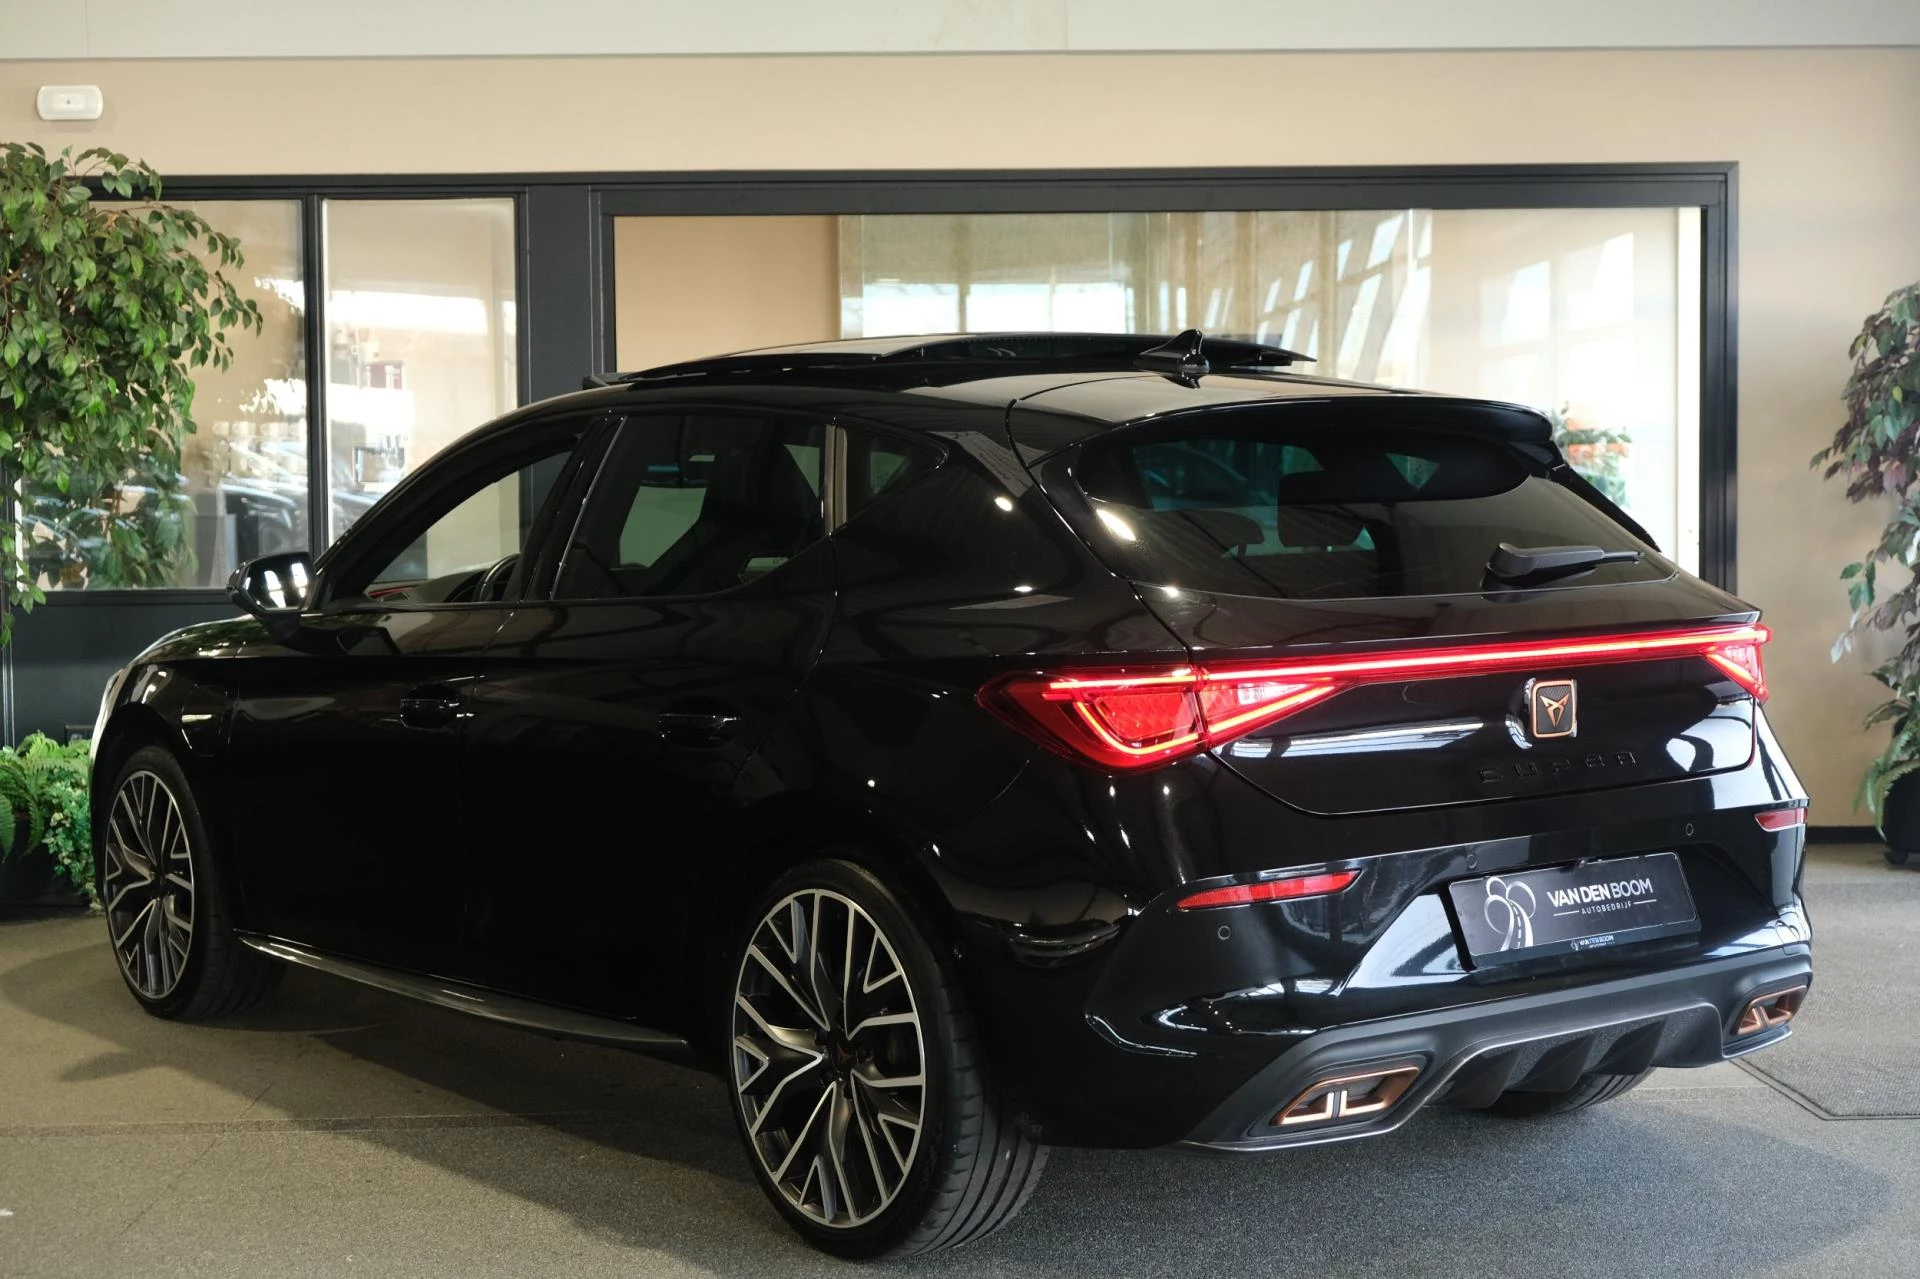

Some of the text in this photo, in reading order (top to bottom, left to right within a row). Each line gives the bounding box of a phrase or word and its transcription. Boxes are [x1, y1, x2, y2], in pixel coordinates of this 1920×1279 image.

[1547, 878, 1654, 908] VAN DEN BOOM
[1581, 901, 1632, 915] AUTOBEDRIJF
